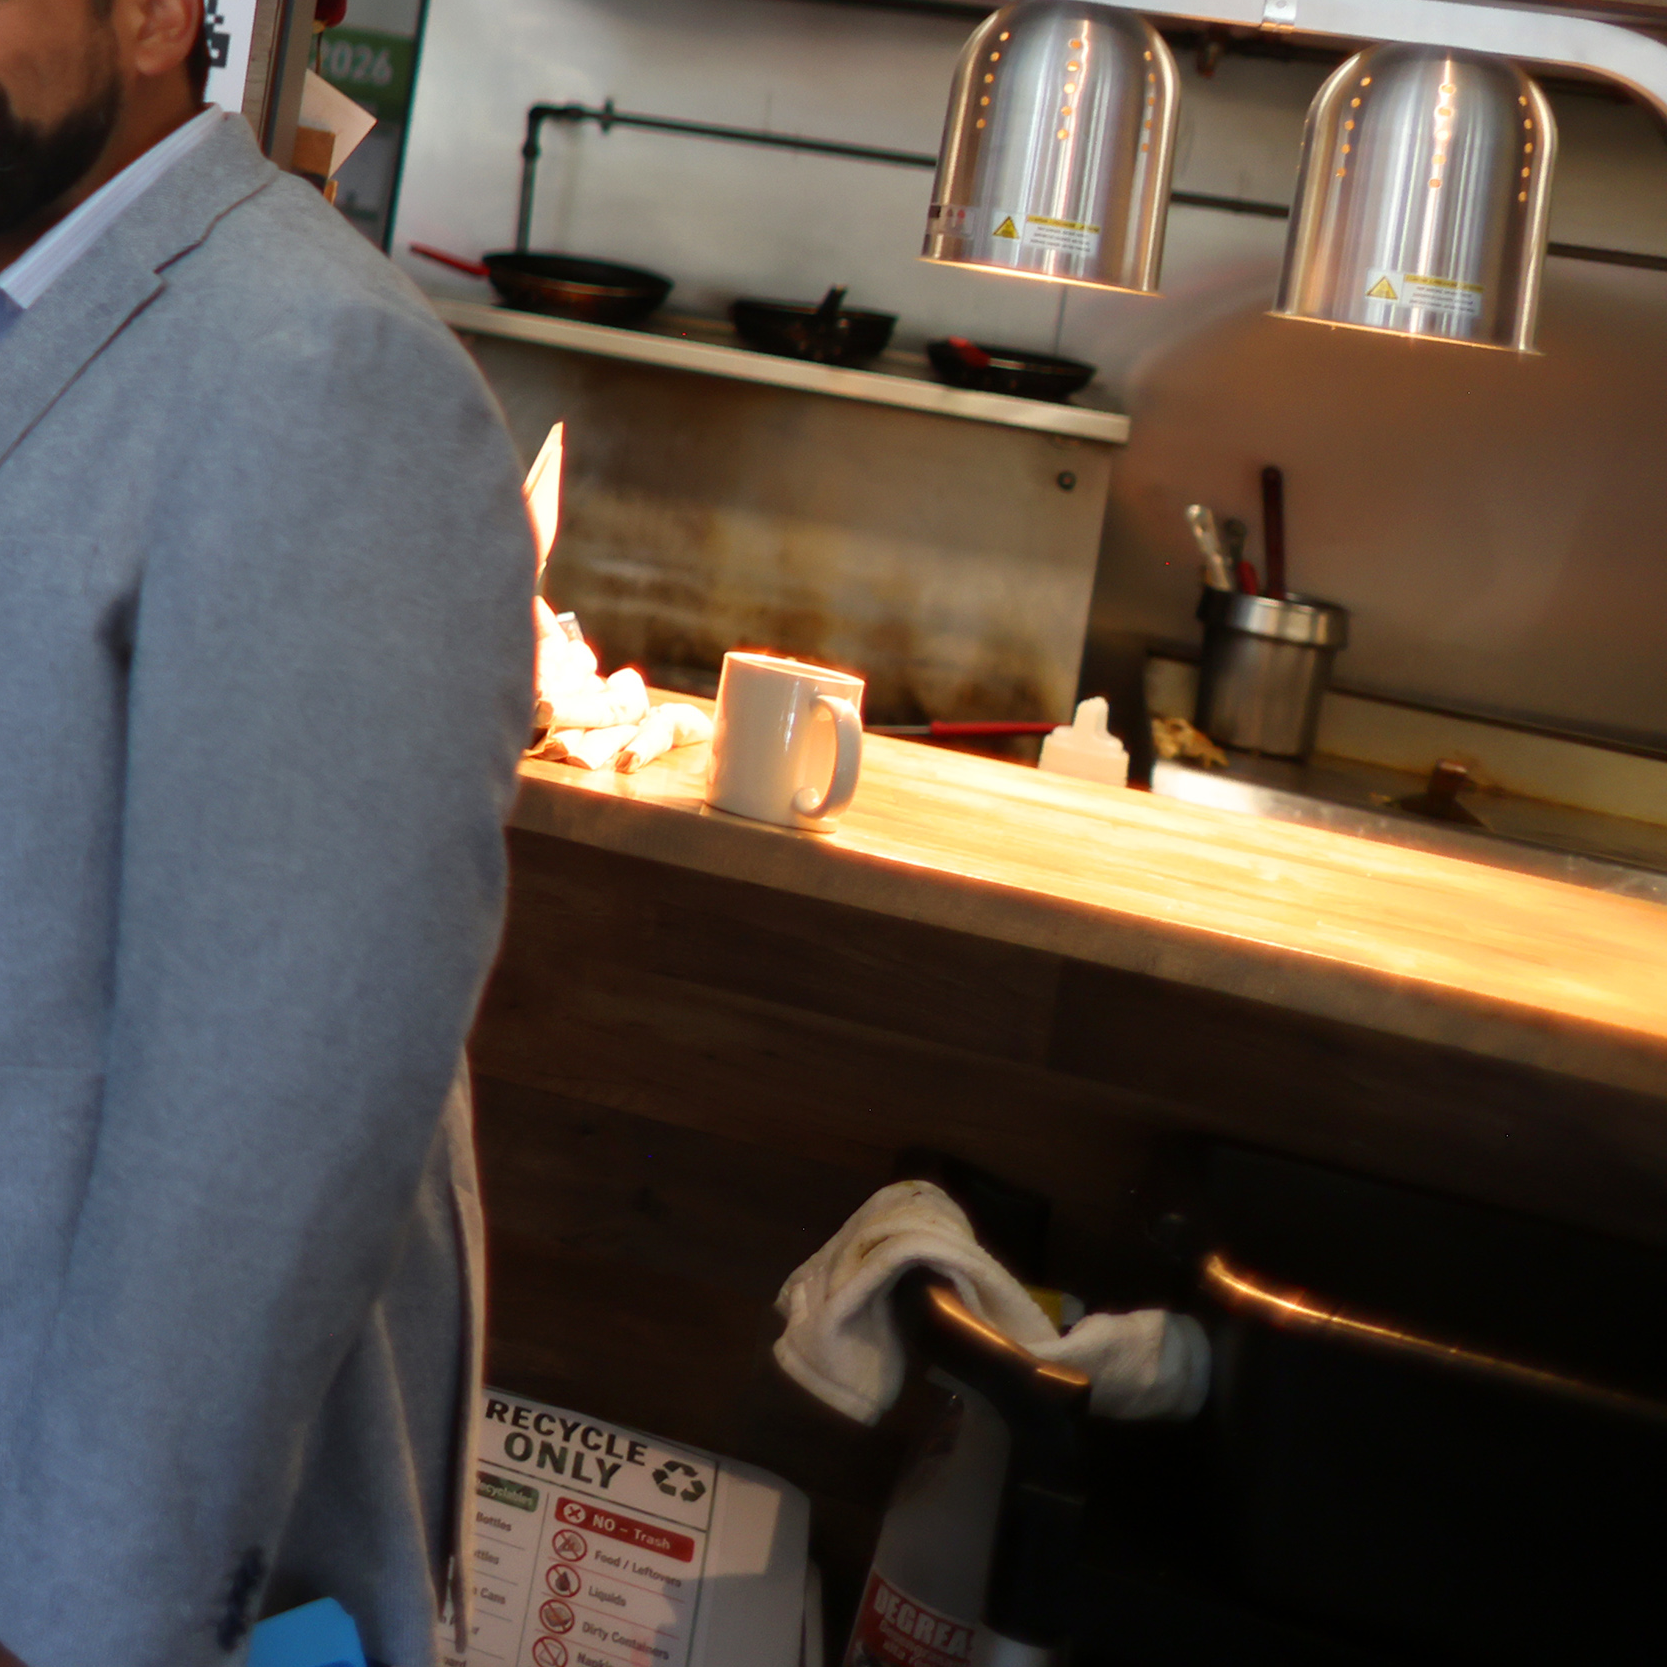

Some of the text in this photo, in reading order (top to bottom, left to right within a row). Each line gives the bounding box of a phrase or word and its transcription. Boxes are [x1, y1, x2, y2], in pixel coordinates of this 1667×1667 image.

[485, 1398, 646, 1467] RECYCLE
[504, 1431, 622, 1489] ONLY
[475, 1511, 512, 1532] Bottles
[592, 1514, 616, 1532] NO
[634, 1528, 671, 1550] Trash
[595, 1549, 622, 1568] Food
[632, 1562, 682, 1588] Leftovers
[480, 1586, 506, 1605] Cans
[588, 1585, 627, 1607] Liquids
[582, 1621, 670, 1660] Dirty Containers
[873, 1583, 970, 1660] DEGREA
